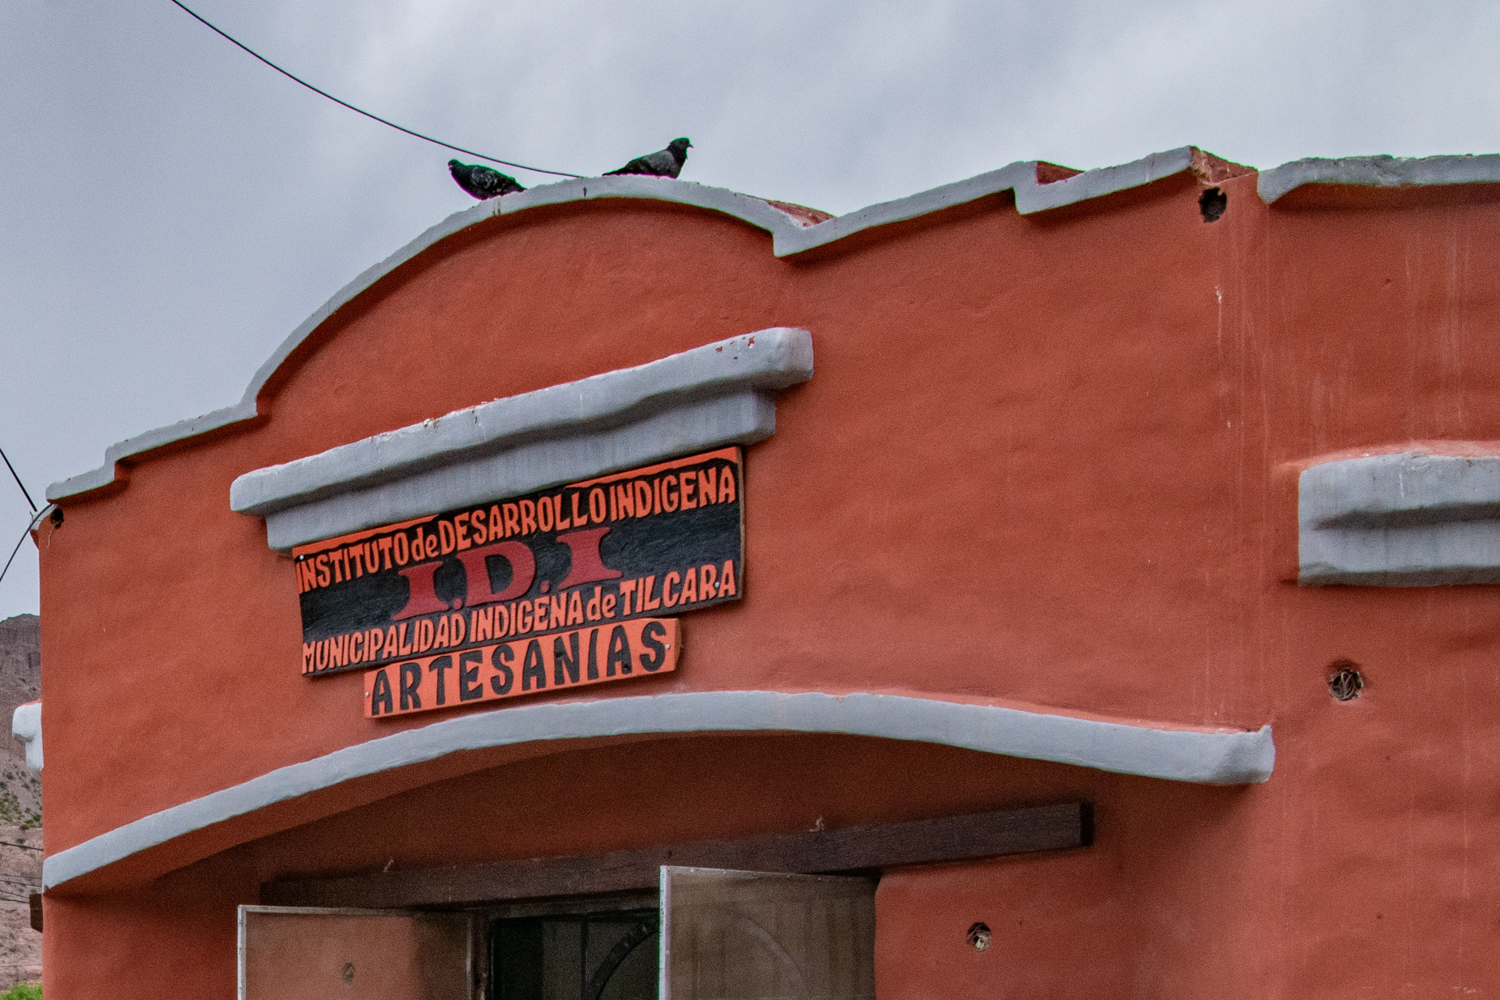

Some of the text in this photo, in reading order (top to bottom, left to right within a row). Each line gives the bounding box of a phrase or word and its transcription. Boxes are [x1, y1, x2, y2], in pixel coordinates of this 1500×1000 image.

[296, 465, 736, 593] INSTITUTO de DESARROLLO INDIGENA
[302, 560, 736, 674] MUNICIPALIDAD INDIGENA de TILCARA
[370, 621, 668, 716] ARTESANIAS
